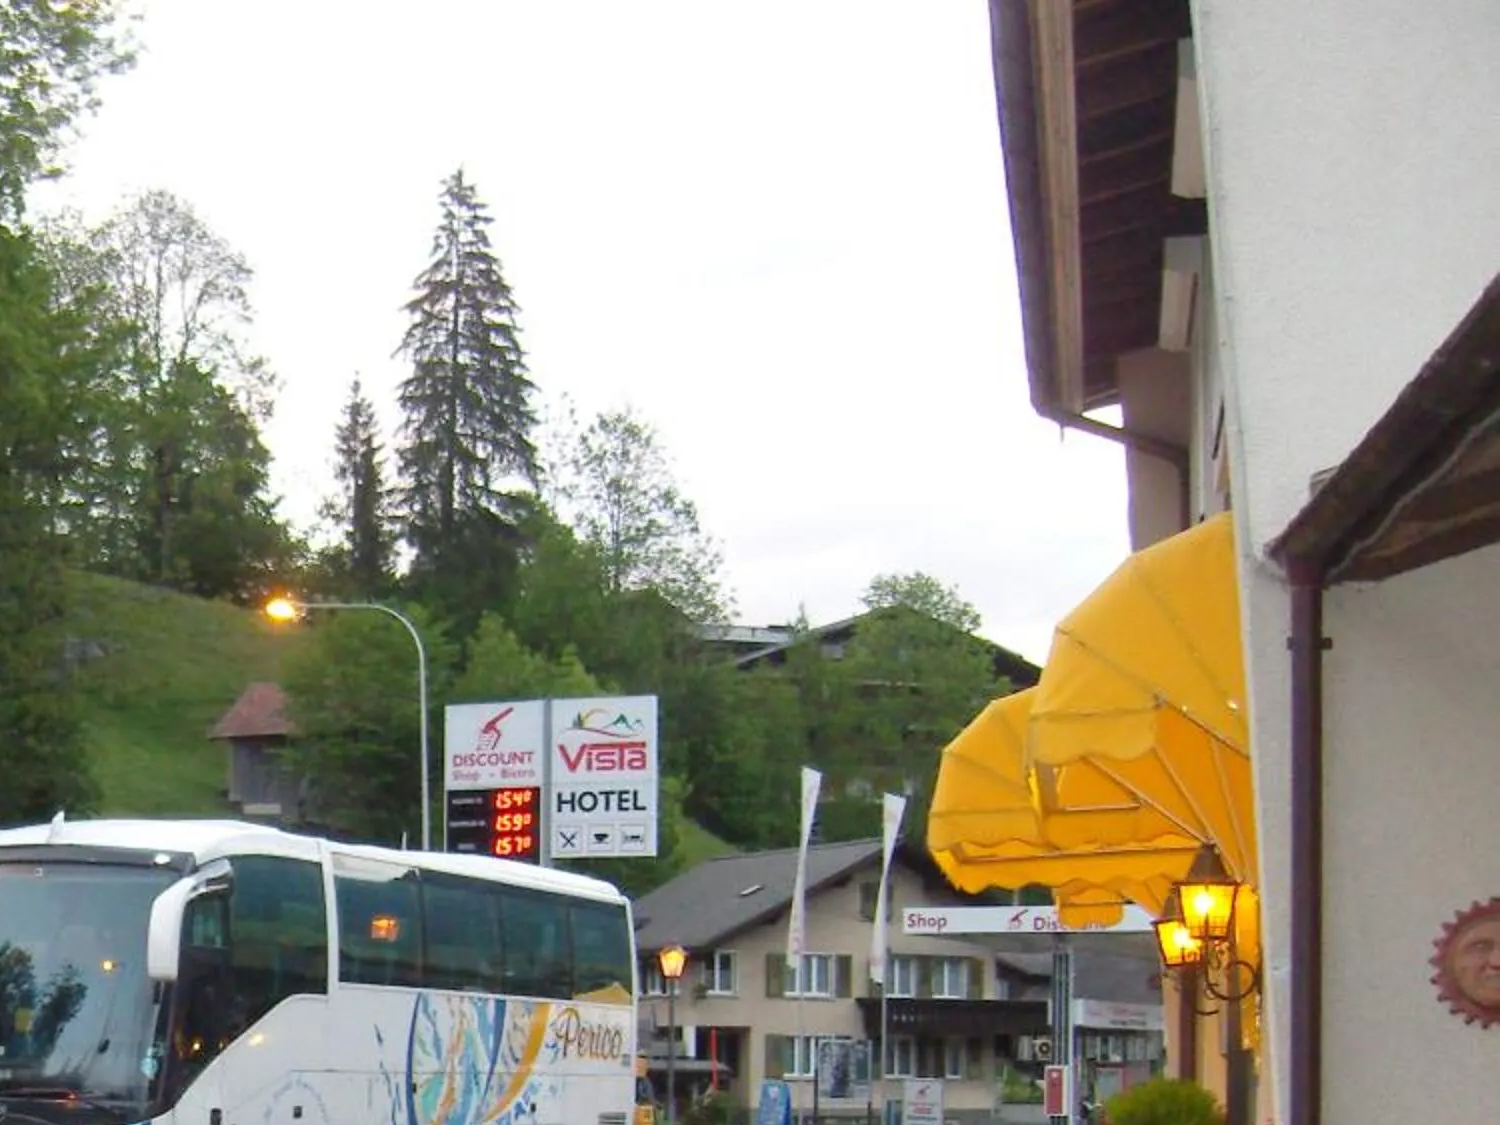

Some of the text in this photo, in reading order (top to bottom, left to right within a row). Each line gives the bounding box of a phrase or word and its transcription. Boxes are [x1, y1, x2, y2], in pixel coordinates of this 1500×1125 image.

[452, 751, 534, 767] DISCOUNT
[557, 789, 647, 813] HOTEL
[906, 911, 948, 931] Shop
